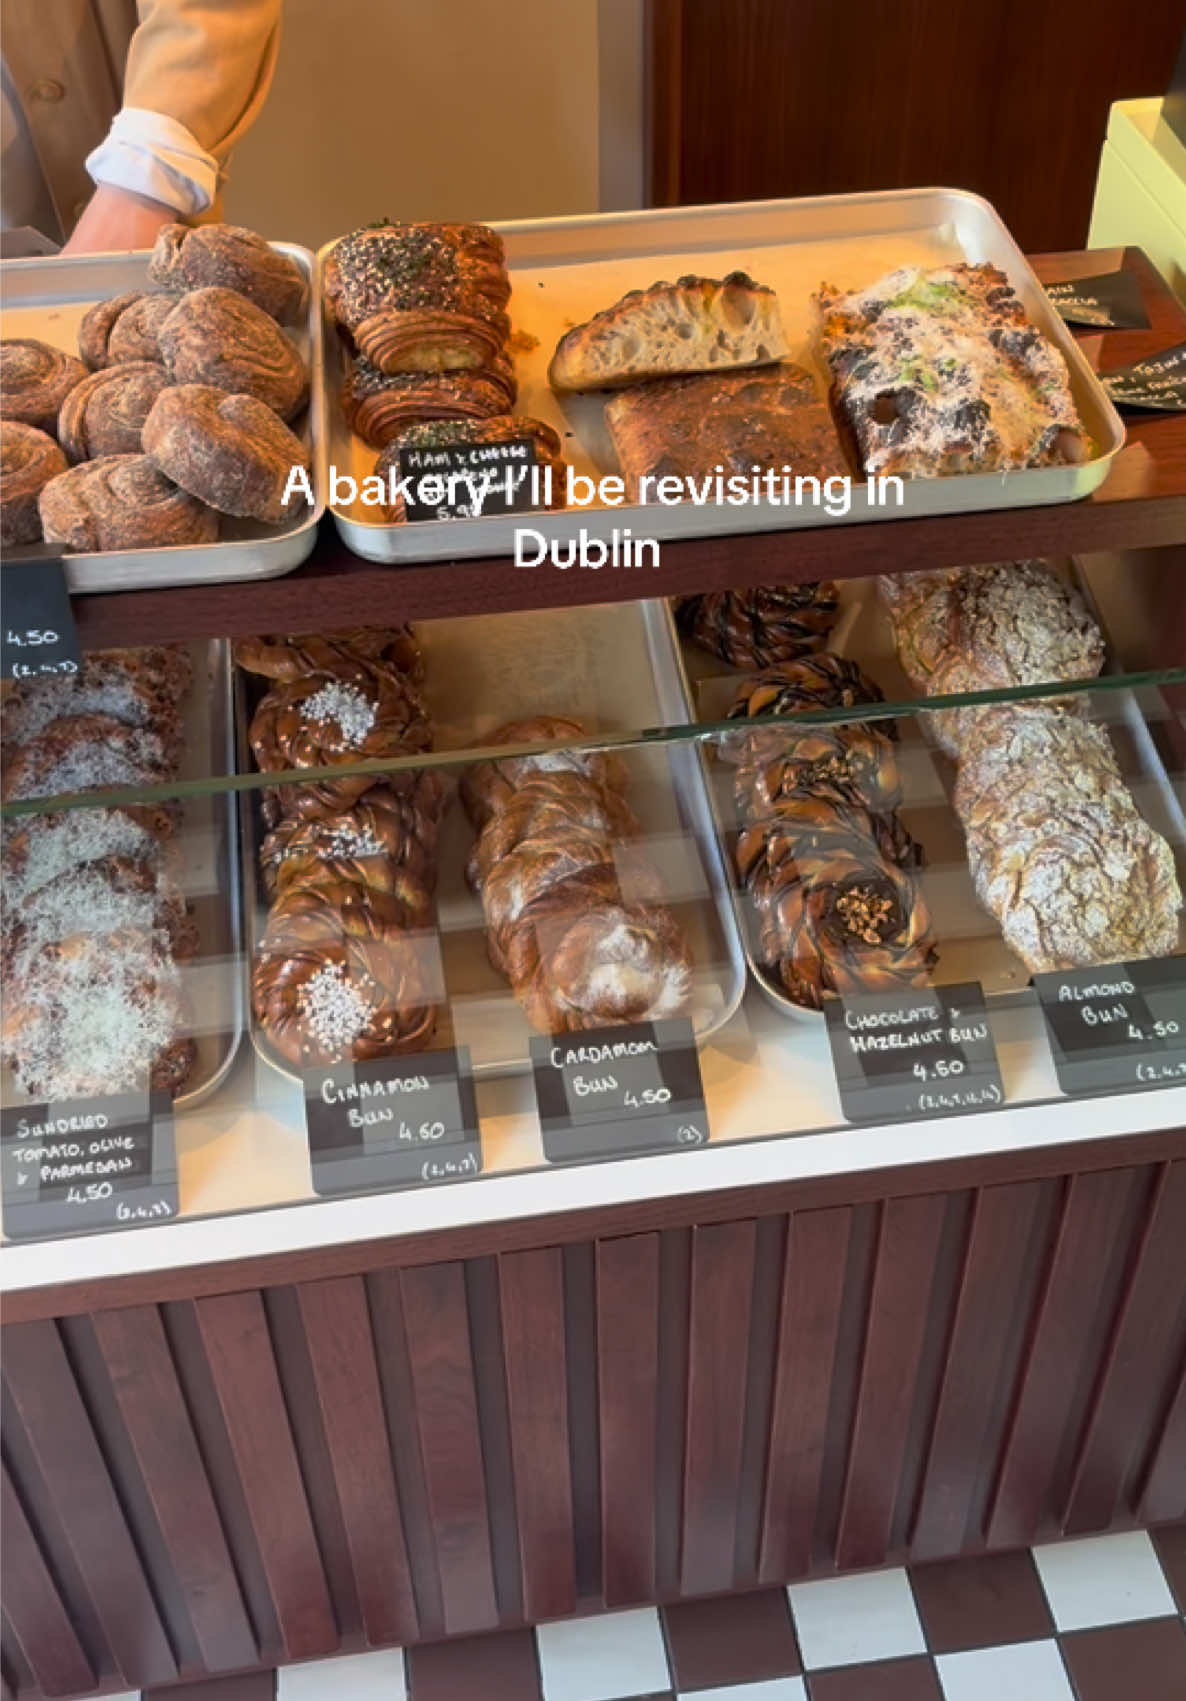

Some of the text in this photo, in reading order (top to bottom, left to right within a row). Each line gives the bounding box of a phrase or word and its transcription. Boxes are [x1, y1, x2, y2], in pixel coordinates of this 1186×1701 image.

[7, 629, 59, 647] 4.50
[1058, 981, 1136, 1003] ALMOND
[845, 1005, 938, 1031] CHOCOLATE
[1081, 1003, 1129, 1027] BUN
[849, 1023, 987, 1053] HAZELNUT BUN
[1128, 1020, 1180, 1041] 4.50
[551, 1041, 659, 1069] CARDAMOM
[912, 1060, 964, 1082] 4.60
[321, 1076, 430, 1104] CINNAMON
[573, 1075, 619, 1097] BUN
[624, 1088, 672, 1108] 4.50
[17, 1114, 109, 1139] SUNDRIED
[348, 1107, 394, 1128] BUN
[89, 1136, 136, 1155] OLIVE
[66, 1181, 113, 1205] 4.50
